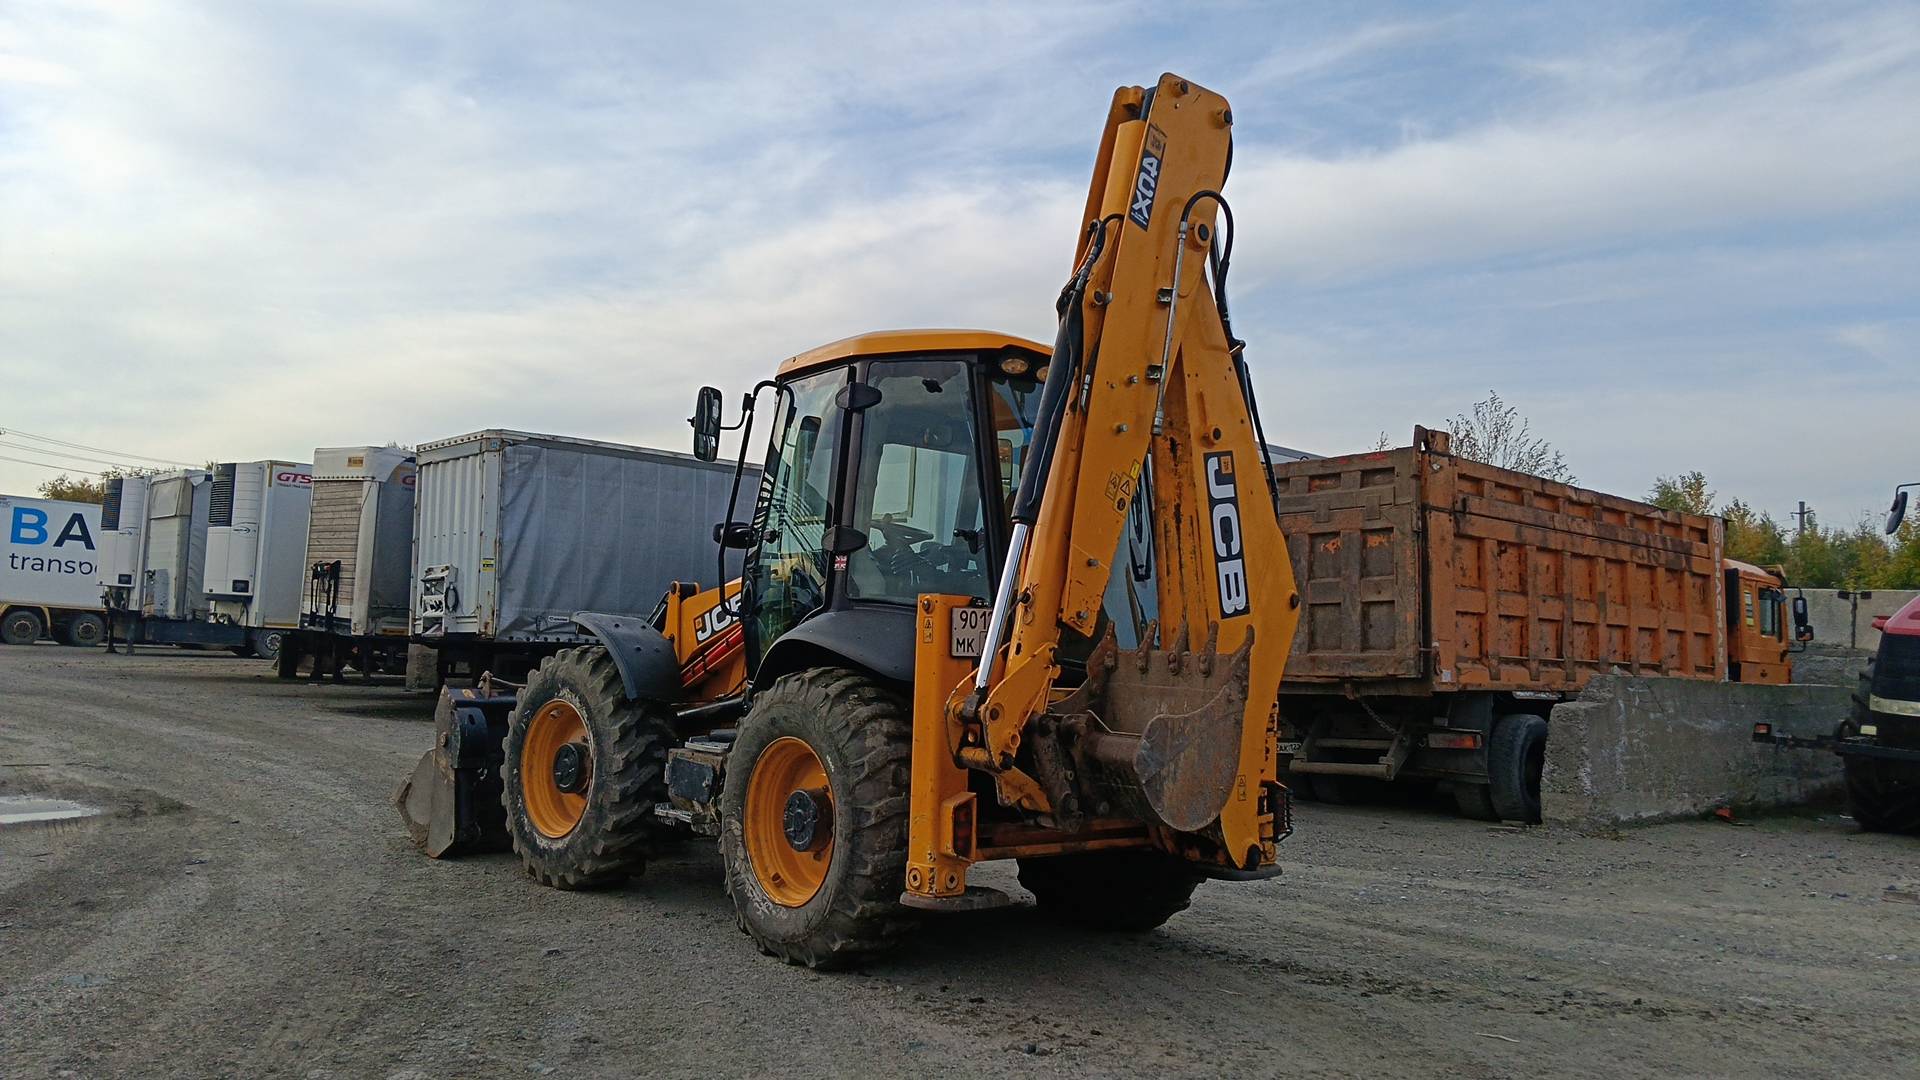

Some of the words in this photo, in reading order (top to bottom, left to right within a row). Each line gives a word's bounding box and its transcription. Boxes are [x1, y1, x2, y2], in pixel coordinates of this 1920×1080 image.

[276, 472, 313, 484] GTS
[10, 506, 96, 551] BA
[1207, 456, 1247, 615] JCB
[956, 637, 975, 653] MK
